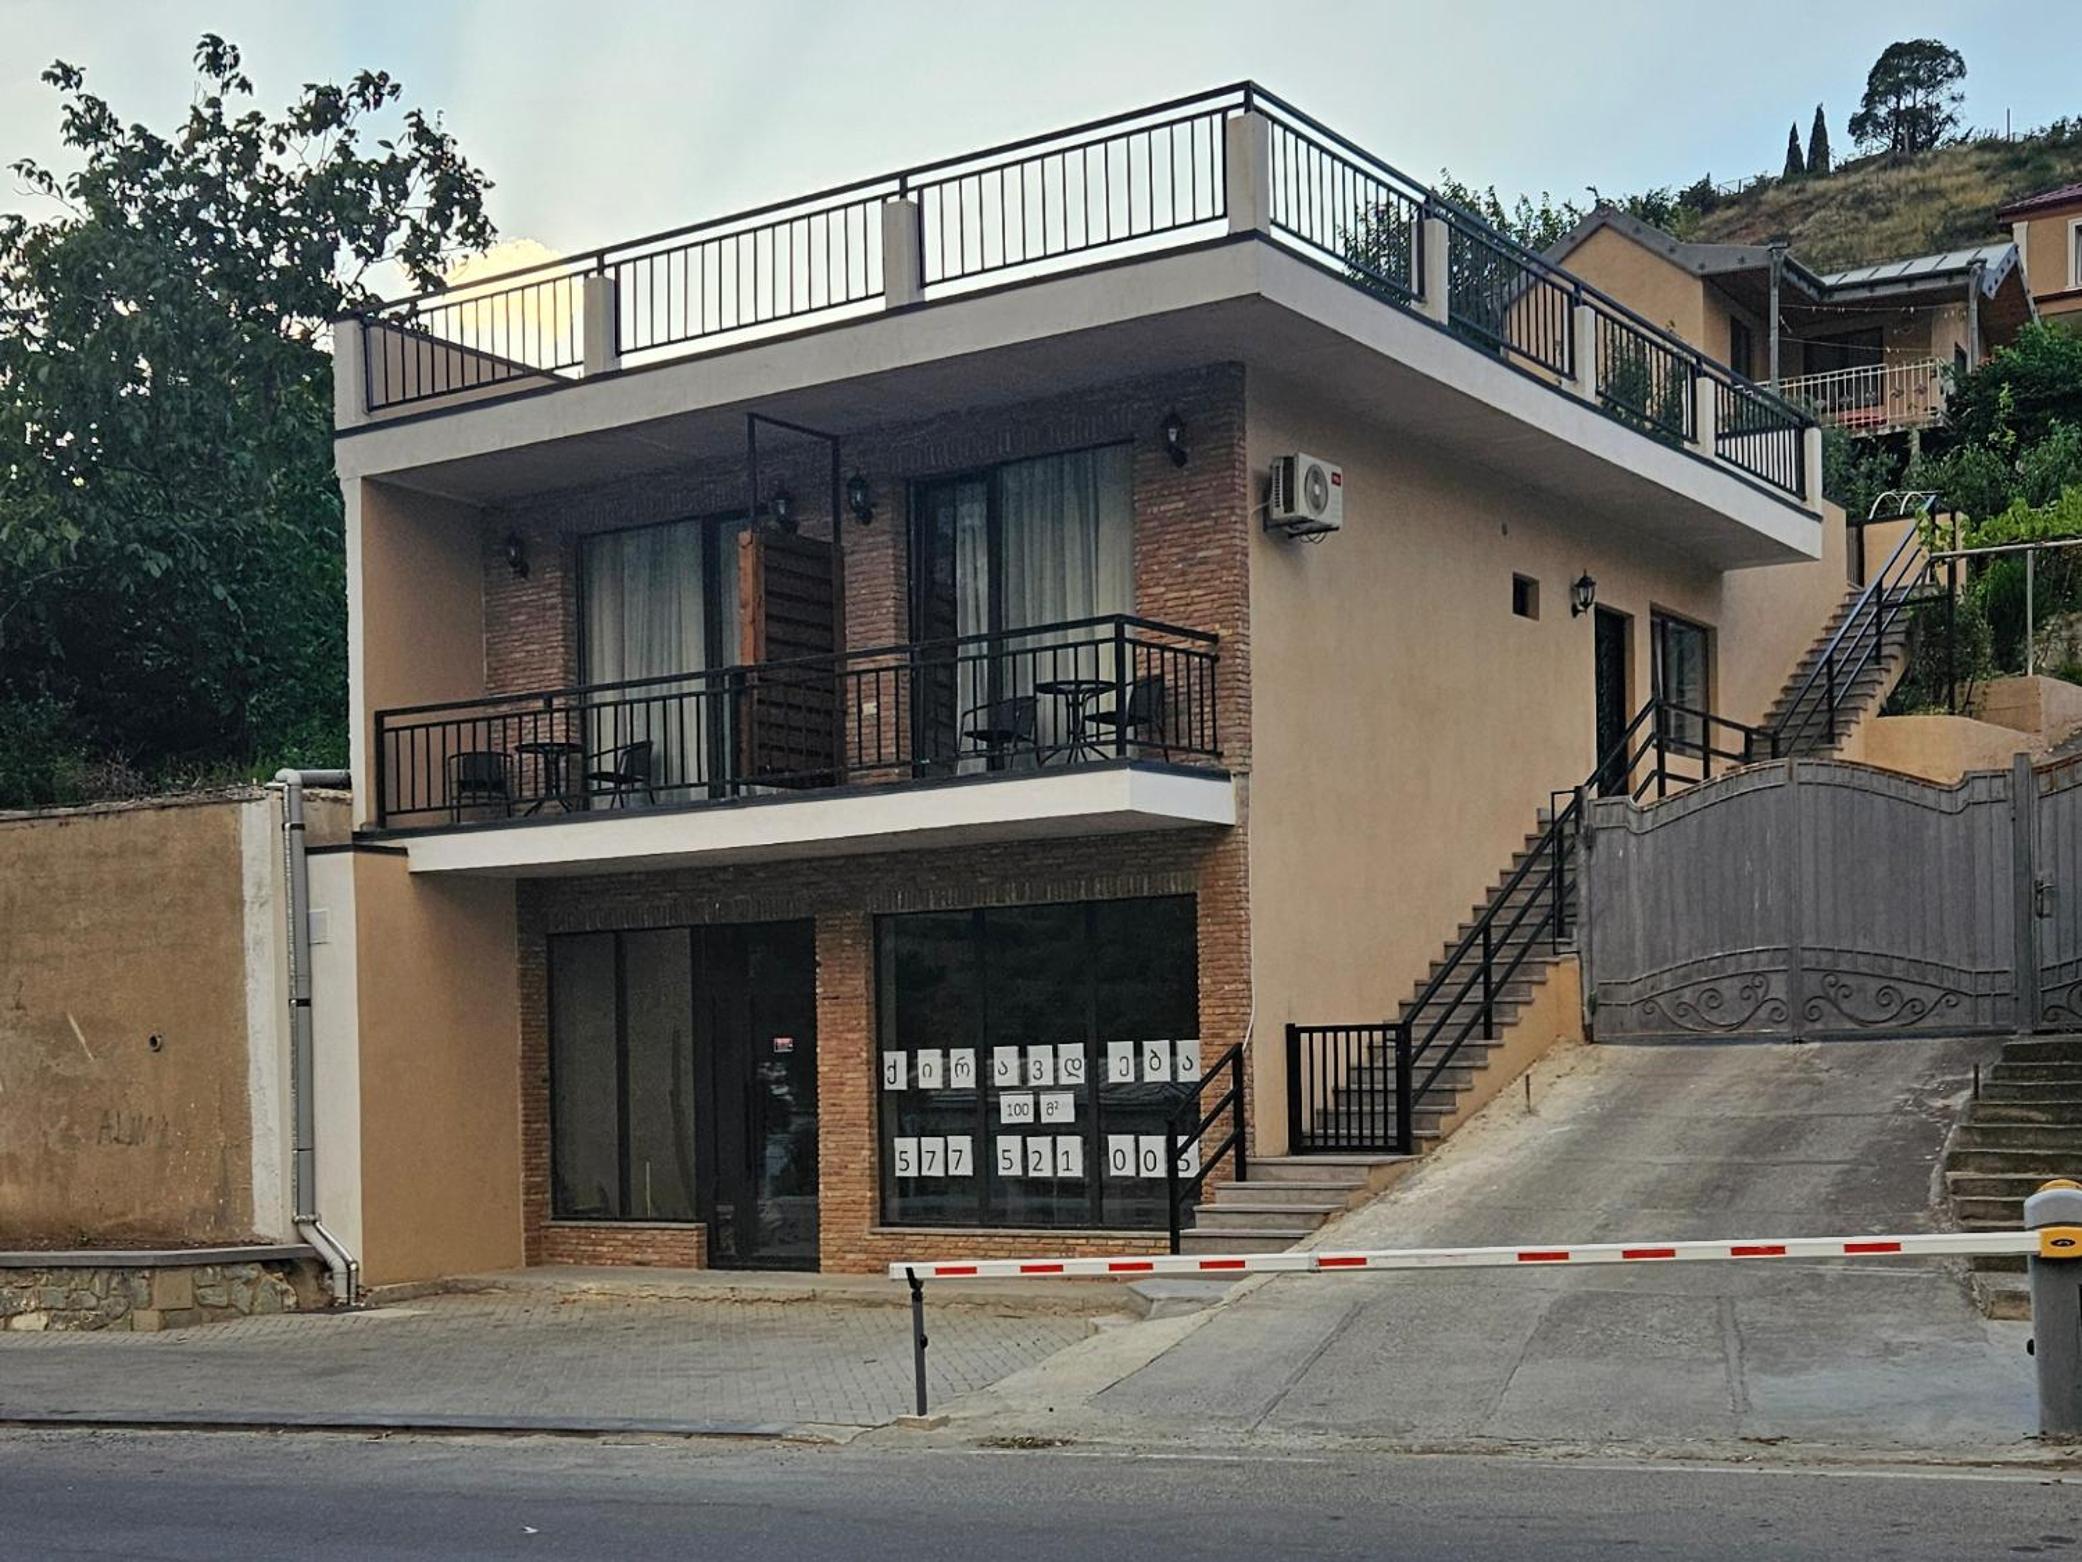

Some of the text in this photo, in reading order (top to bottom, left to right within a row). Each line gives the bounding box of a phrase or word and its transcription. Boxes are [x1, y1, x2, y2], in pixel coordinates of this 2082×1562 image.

[1007, 1103, 1030, 1116] 100
[898, 1149, 963, 1172] 577
[1001, 1149, 1073, 1172] 521
